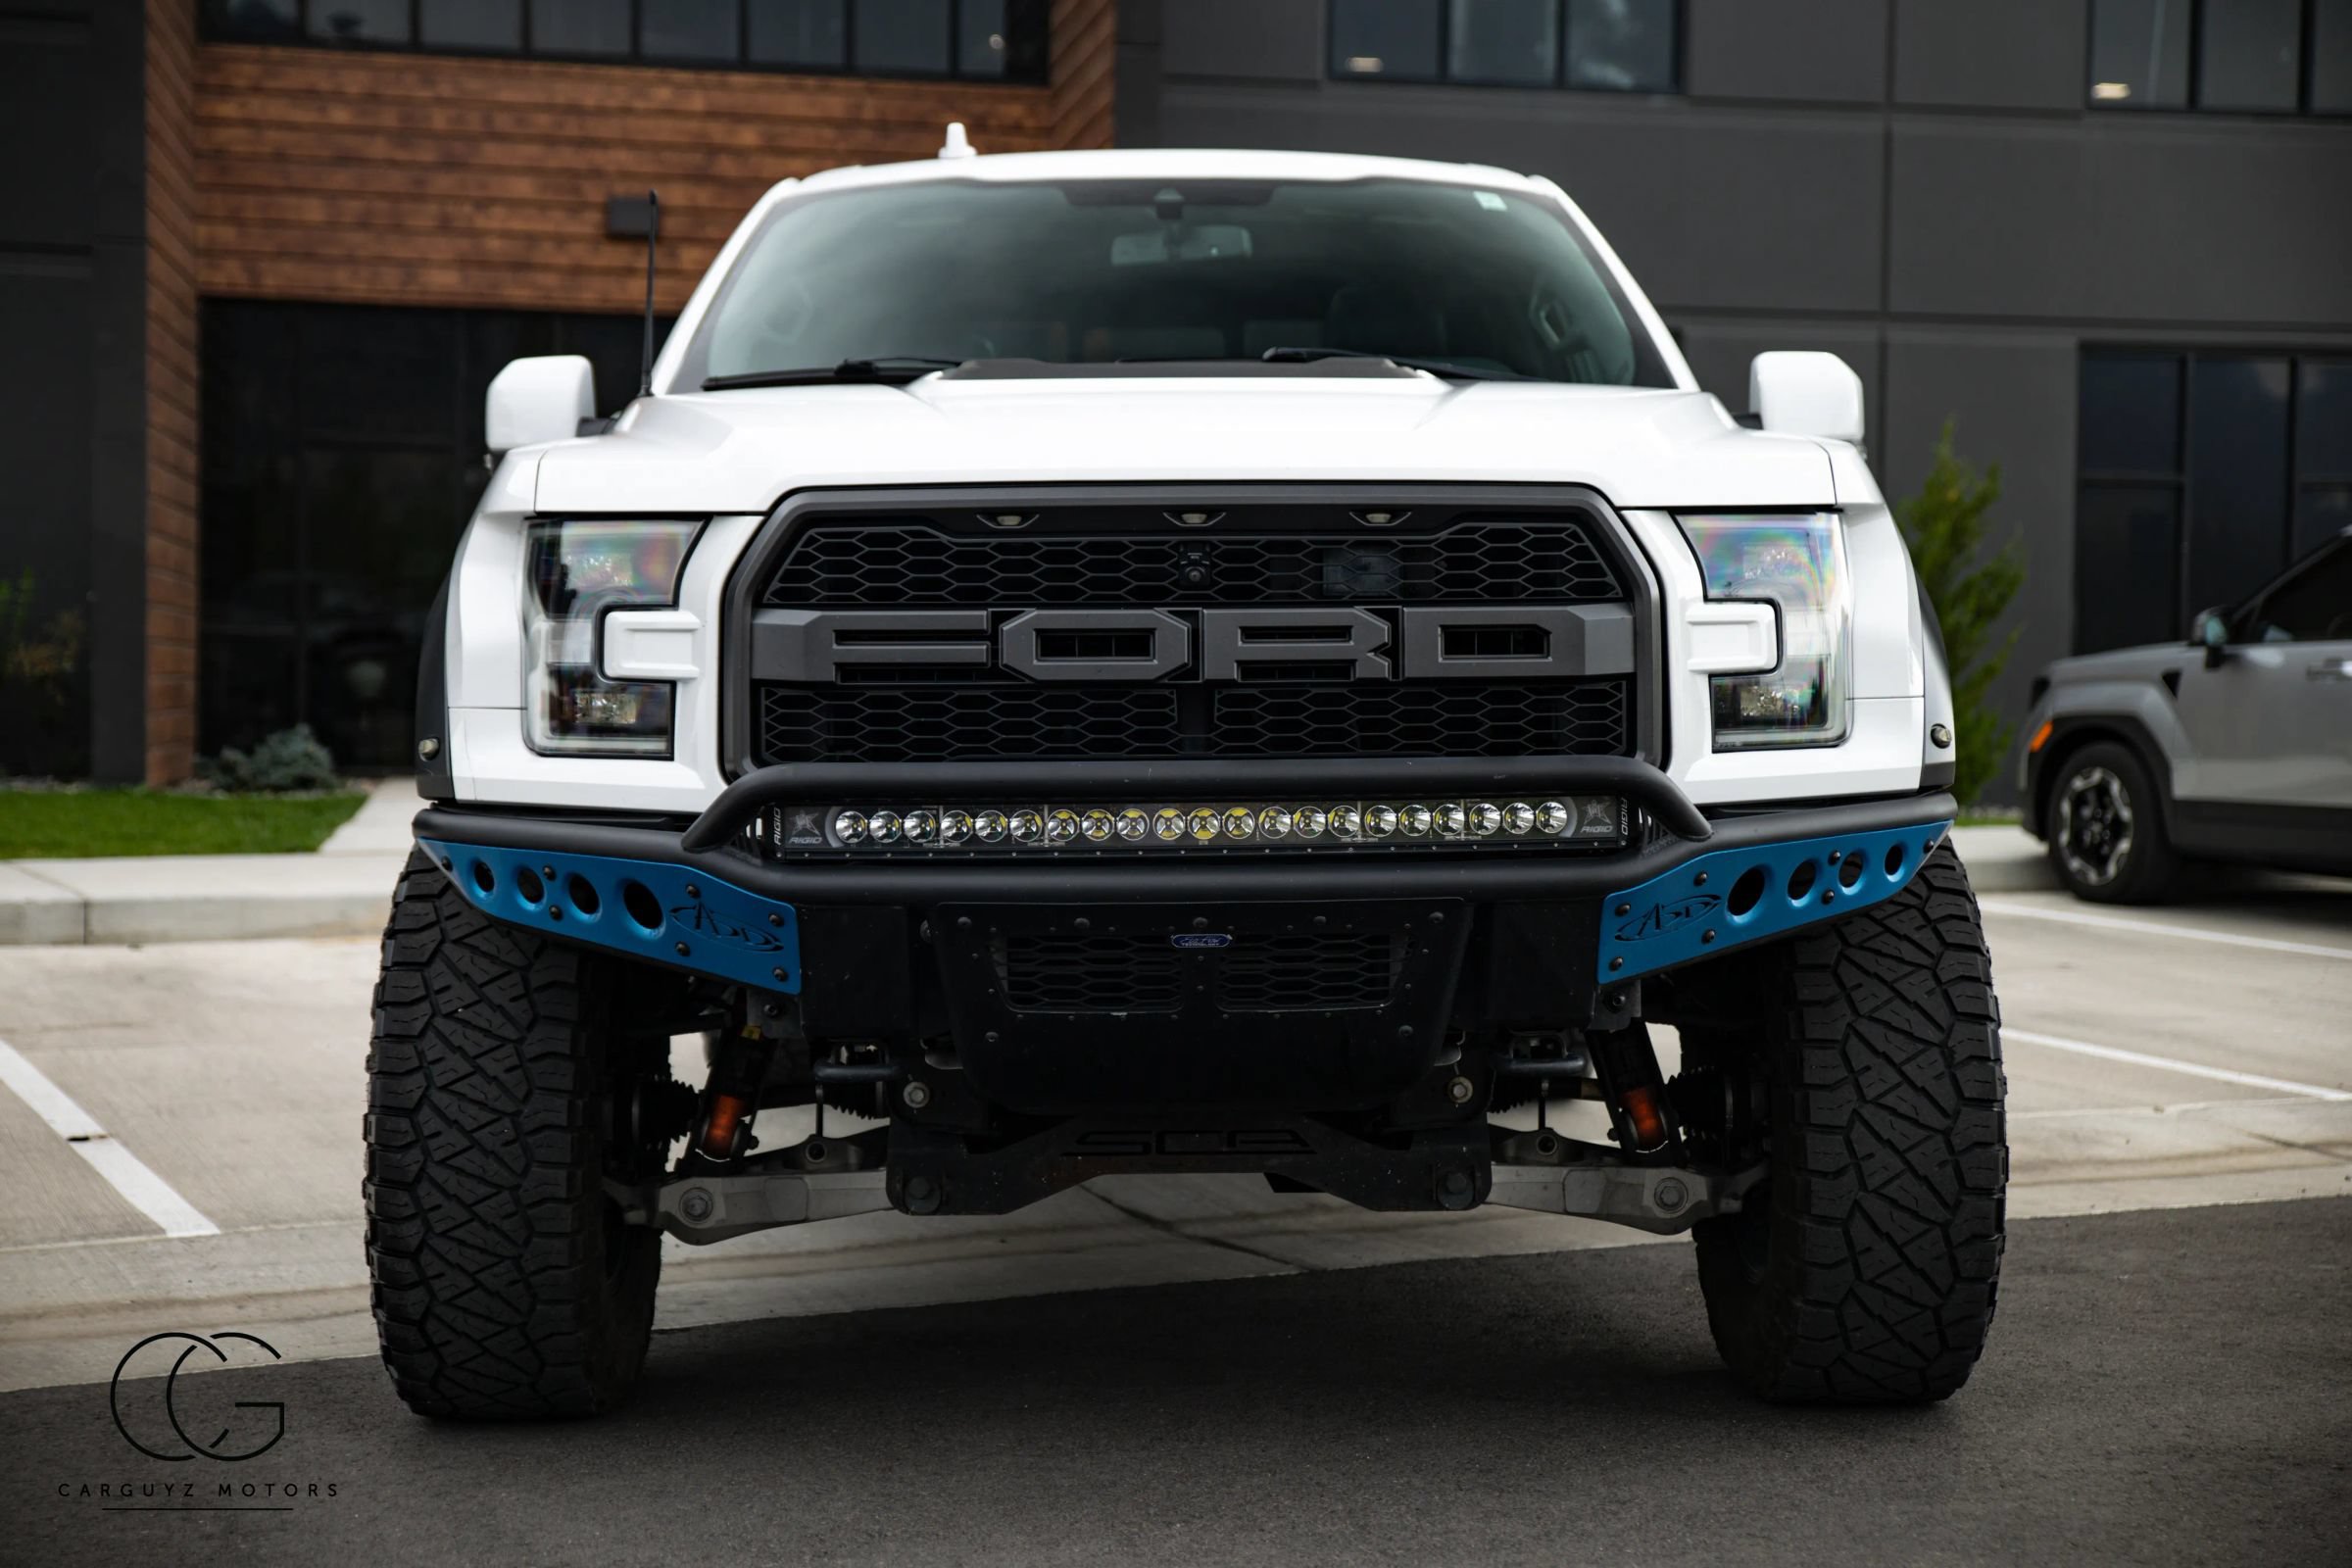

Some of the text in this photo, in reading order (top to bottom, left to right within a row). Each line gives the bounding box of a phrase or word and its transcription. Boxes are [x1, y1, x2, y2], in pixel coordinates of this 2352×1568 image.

[752, 602, 1634, 683] FORD
[773, 807, 782, 846] RIGID
[1620, 797, 1629, 836] RIGID
[788, 836, 823, 845] RIGID
